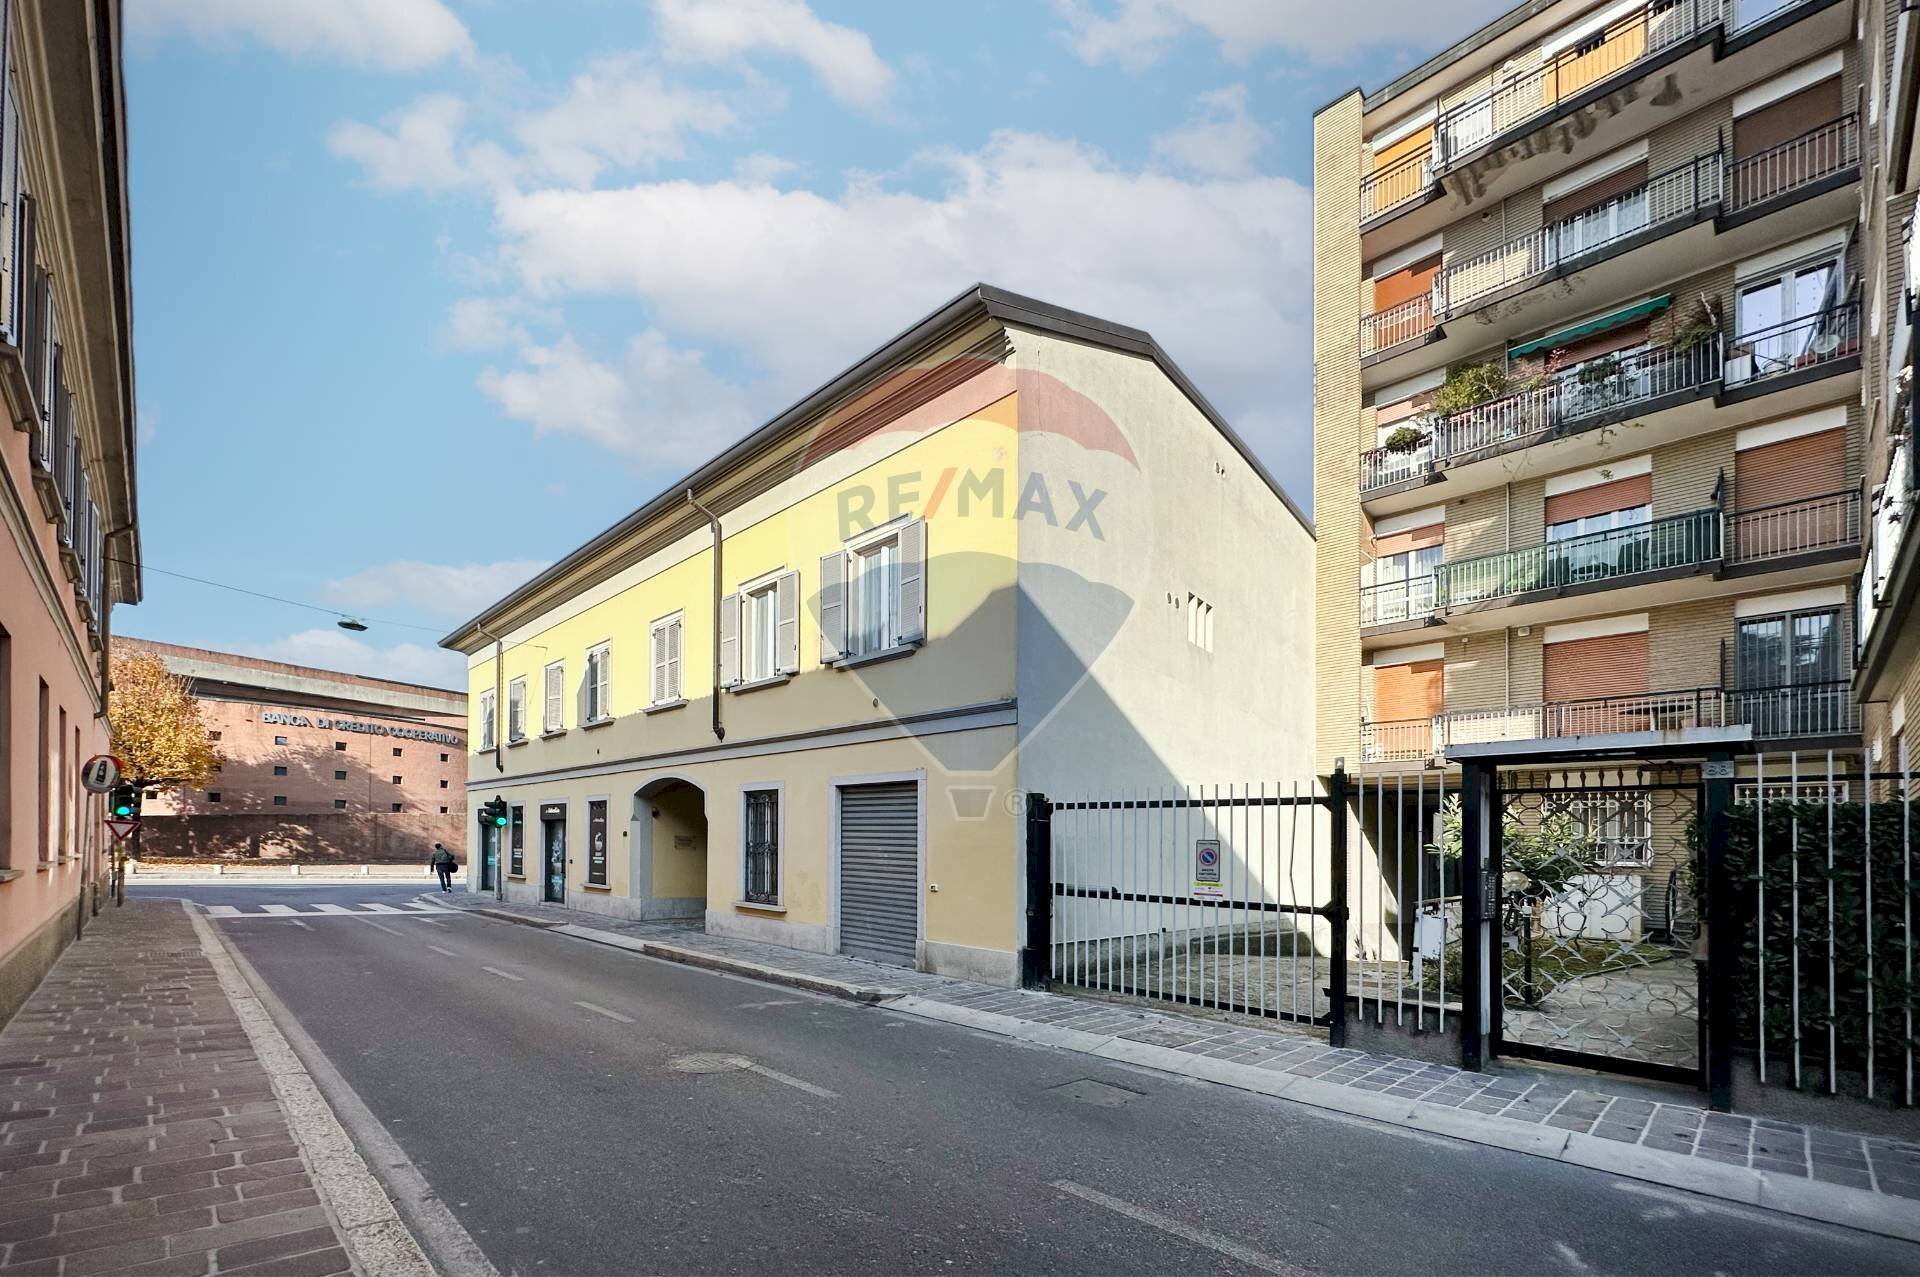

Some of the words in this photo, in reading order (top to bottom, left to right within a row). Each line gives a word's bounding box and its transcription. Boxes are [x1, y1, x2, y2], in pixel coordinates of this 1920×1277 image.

[262, 712, 308, 727] BANCA
[316, 717, 330, 728] DI
[334, 719, 384, 734] CREDITO
[387, 725, 459, 744] COOPERATIVO
